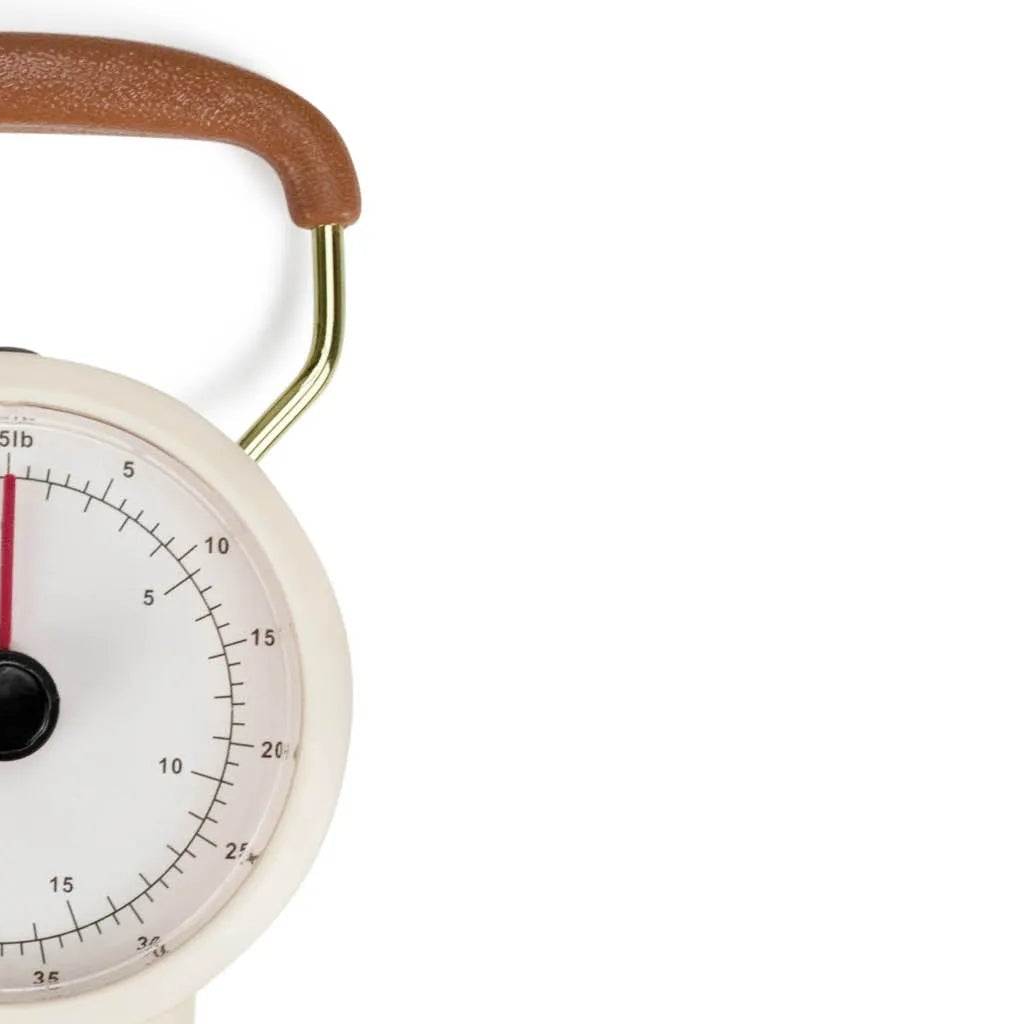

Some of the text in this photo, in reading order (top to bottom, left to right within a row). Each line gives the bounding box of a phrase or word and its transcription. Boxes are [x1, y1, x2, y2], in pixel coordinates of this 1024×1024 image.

[122, 461, 135, 478] 5
[205, 537, 230, 555] 10
[142, 589, 155, 607] 5
[250, 629, 276, 647] 15
[260, 741, 283, 759] 20
[158, 757, 183, 775] 10
[49, 876, 74, 893] 15
